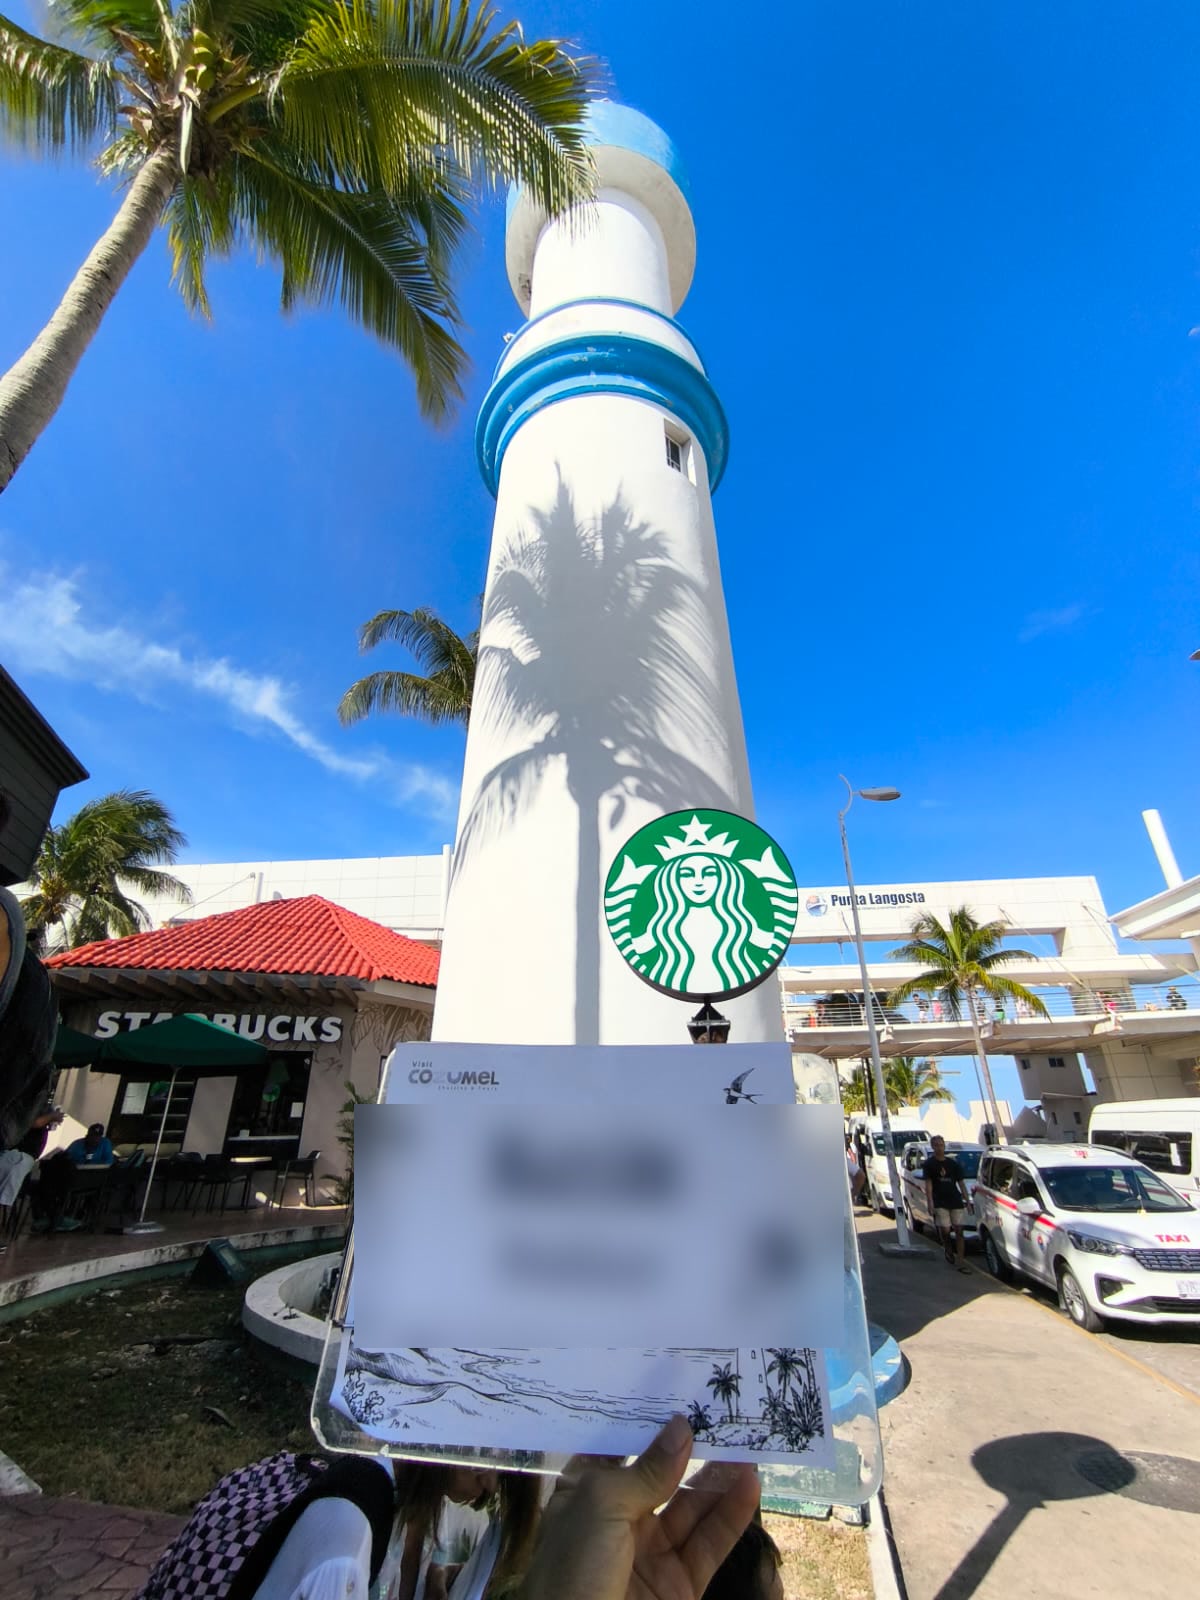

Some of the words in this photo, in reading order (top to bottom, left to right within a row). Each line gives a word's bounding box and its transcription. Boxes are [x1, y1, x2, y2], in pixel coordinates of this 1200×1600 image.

[831, 894, 867, 906] Punta
[869, 892, 925, 905] Langosta
[95, 1011, 343, 1043] STBUCKS
[1154, 1234, 1191, 1243] TAXI
